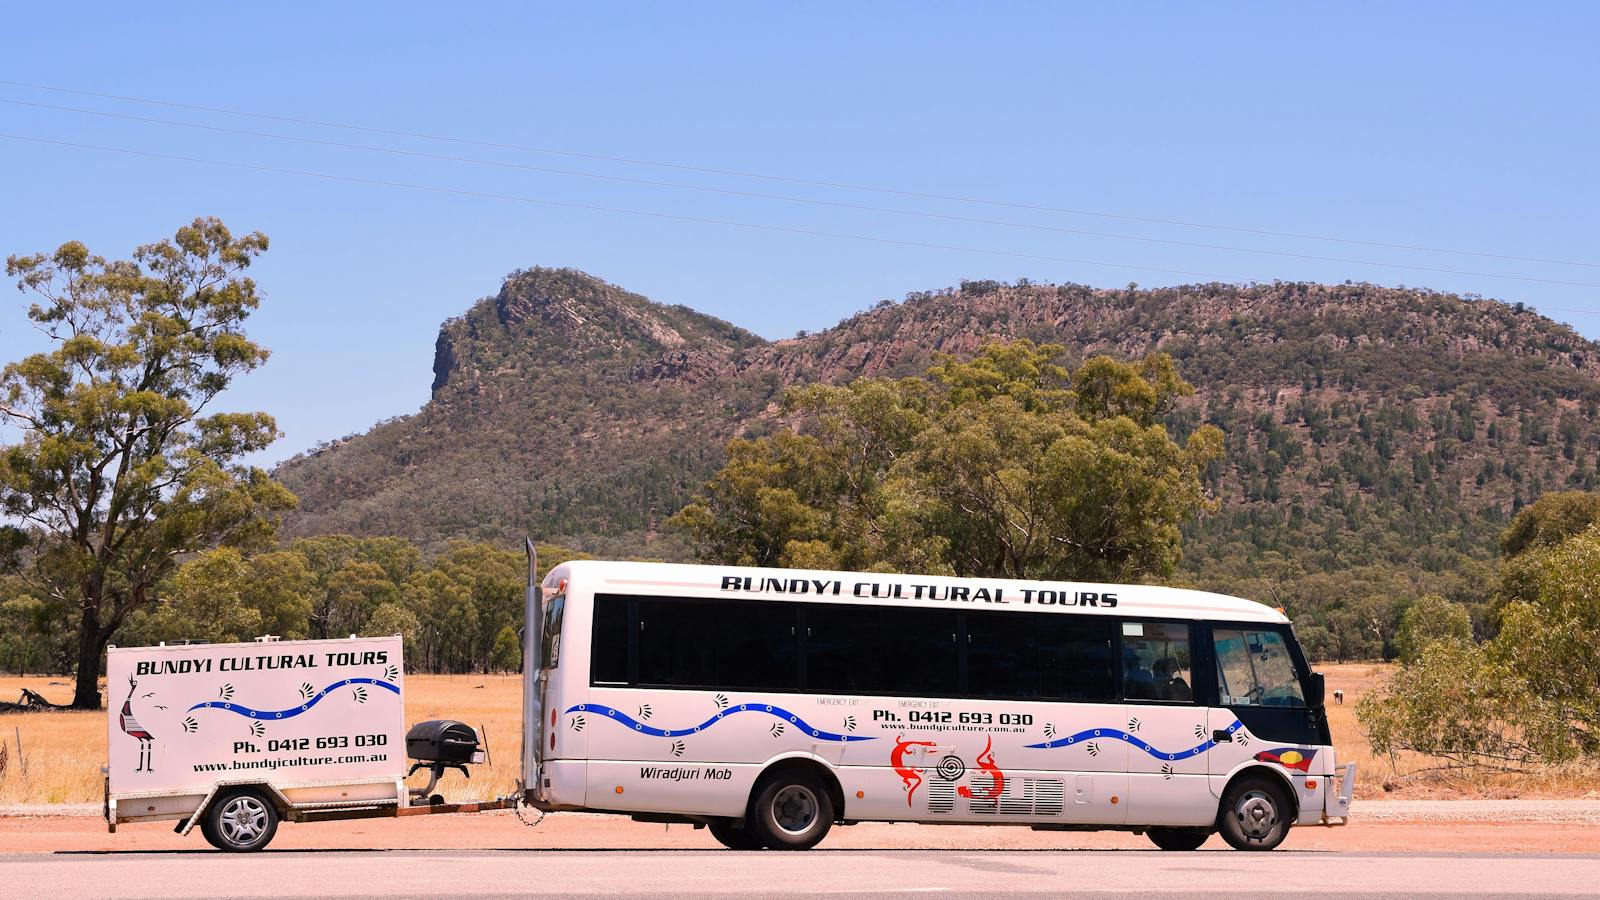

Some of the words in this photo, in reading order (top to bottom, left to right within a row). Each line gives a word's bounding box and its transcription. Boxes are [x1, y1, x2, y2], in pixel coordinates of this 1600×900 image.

[720, 575, 842, 596] BUNDYI
[853, 581, 1010, 604] CULTURAL
[1020, 589, 1119, 608] TOURS
[136, 659, 212, 676] BUNDYI
[219, 654, 318, 672] CULTURAL
[326, 651, 388, 667] TOURS
[816, 697, 846, 706] EMERGENCY
[849, 698, 859, 706] EXIT
[898, 700, 926, 708] EMERGENCY
[873, 709, 901, 722] Ph.
[908, 711, 952, 723] 0412
[959, 712, 993, 724] 693
[999, 713, 1033, 726] 030
[881, 723, 1026, 733] www.bundyiculture.com.au
[233, 740, 261, 754] Ph.
[268, 738, 310, 752] 0412
[316, 736, 349, 749] 693
[354, 734, 387, 747] 030
[193, 754, 387, 772] www.bundyiculture.com.au
[640, 767, 700, 782] Wiradjuri
[704, 768, 732, 780] Mob
